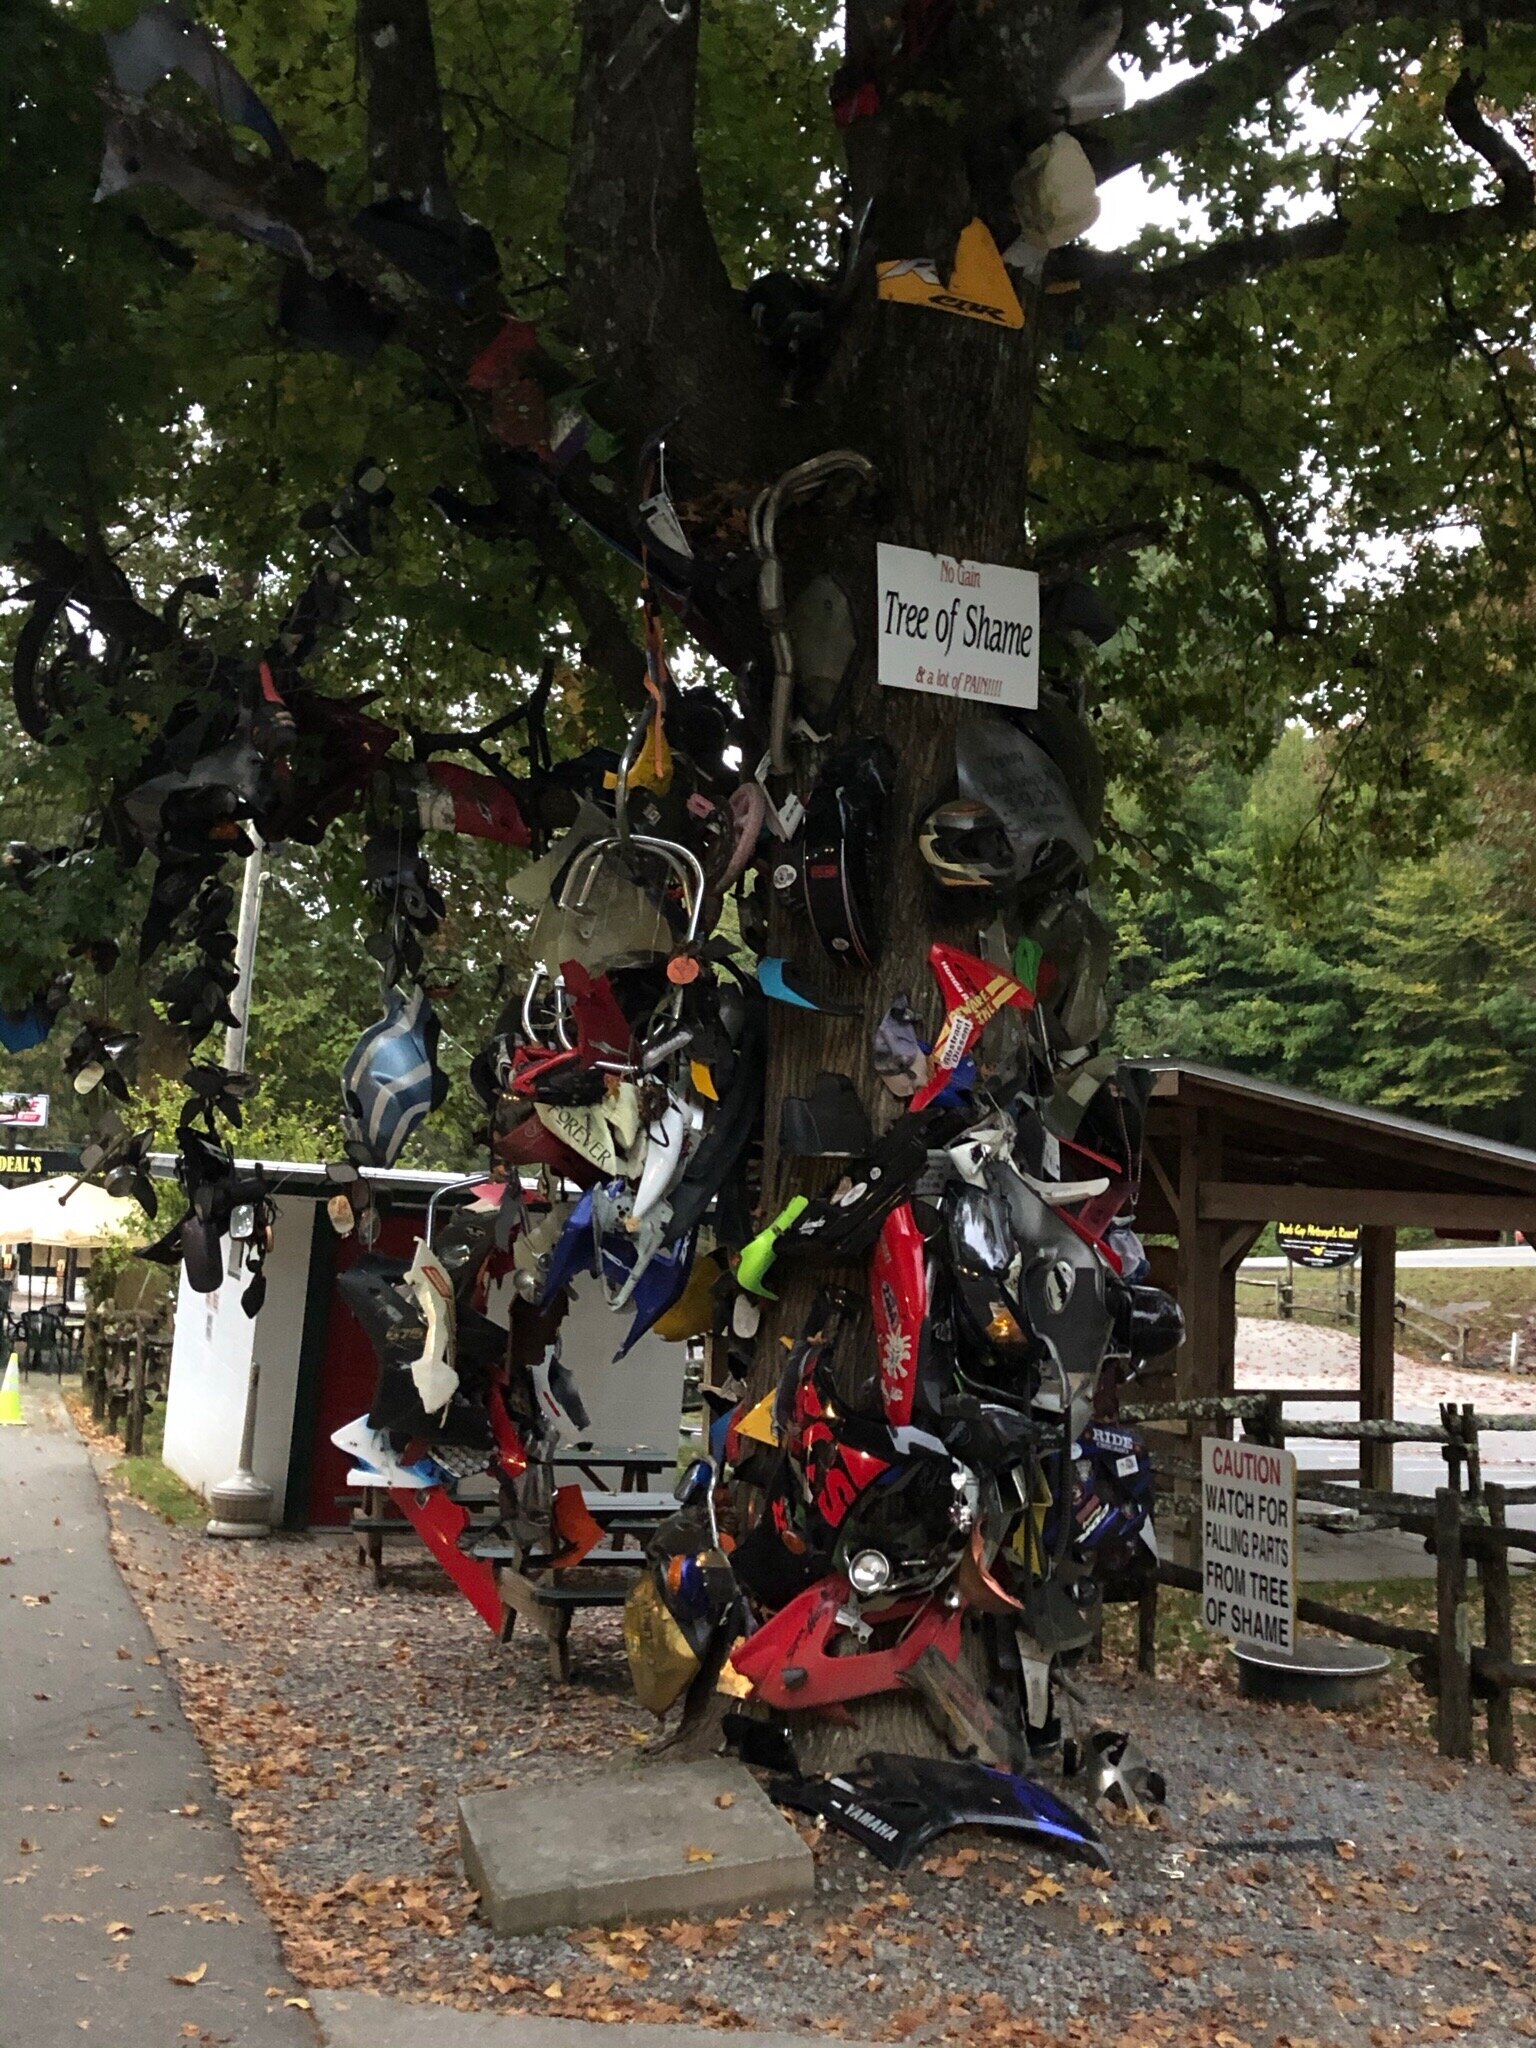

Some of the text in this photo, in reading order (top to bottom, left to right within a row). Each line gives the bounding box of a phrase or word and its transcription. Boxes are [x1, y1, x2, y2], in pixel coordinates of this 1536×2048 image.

[940, 560, 981, 588] No Gain
[885, 590, 1033, 658] Tree of Shame
[915, 666, 926, 683] &
[926, 671, 934, 685] a
[936, 669, 950, 690] lot
[951, 672, 965, 694] of
[941, 960, 964, 993] Honda
[1092, 1427, 1134, 1450] RIDE
[1212, 1446, 1281, 1486] CAUTION
[1205, 1483, 1288, 1528] WATCH FOR
[1205, 1521, 1289, 1569] FALLING PARTS
[1206, 1560, 1289, 1609] FROM TREE
[1206, 1597, 1289, 1648] OF SHAME
[844, 1803, 899, 1842] YAMAHA
